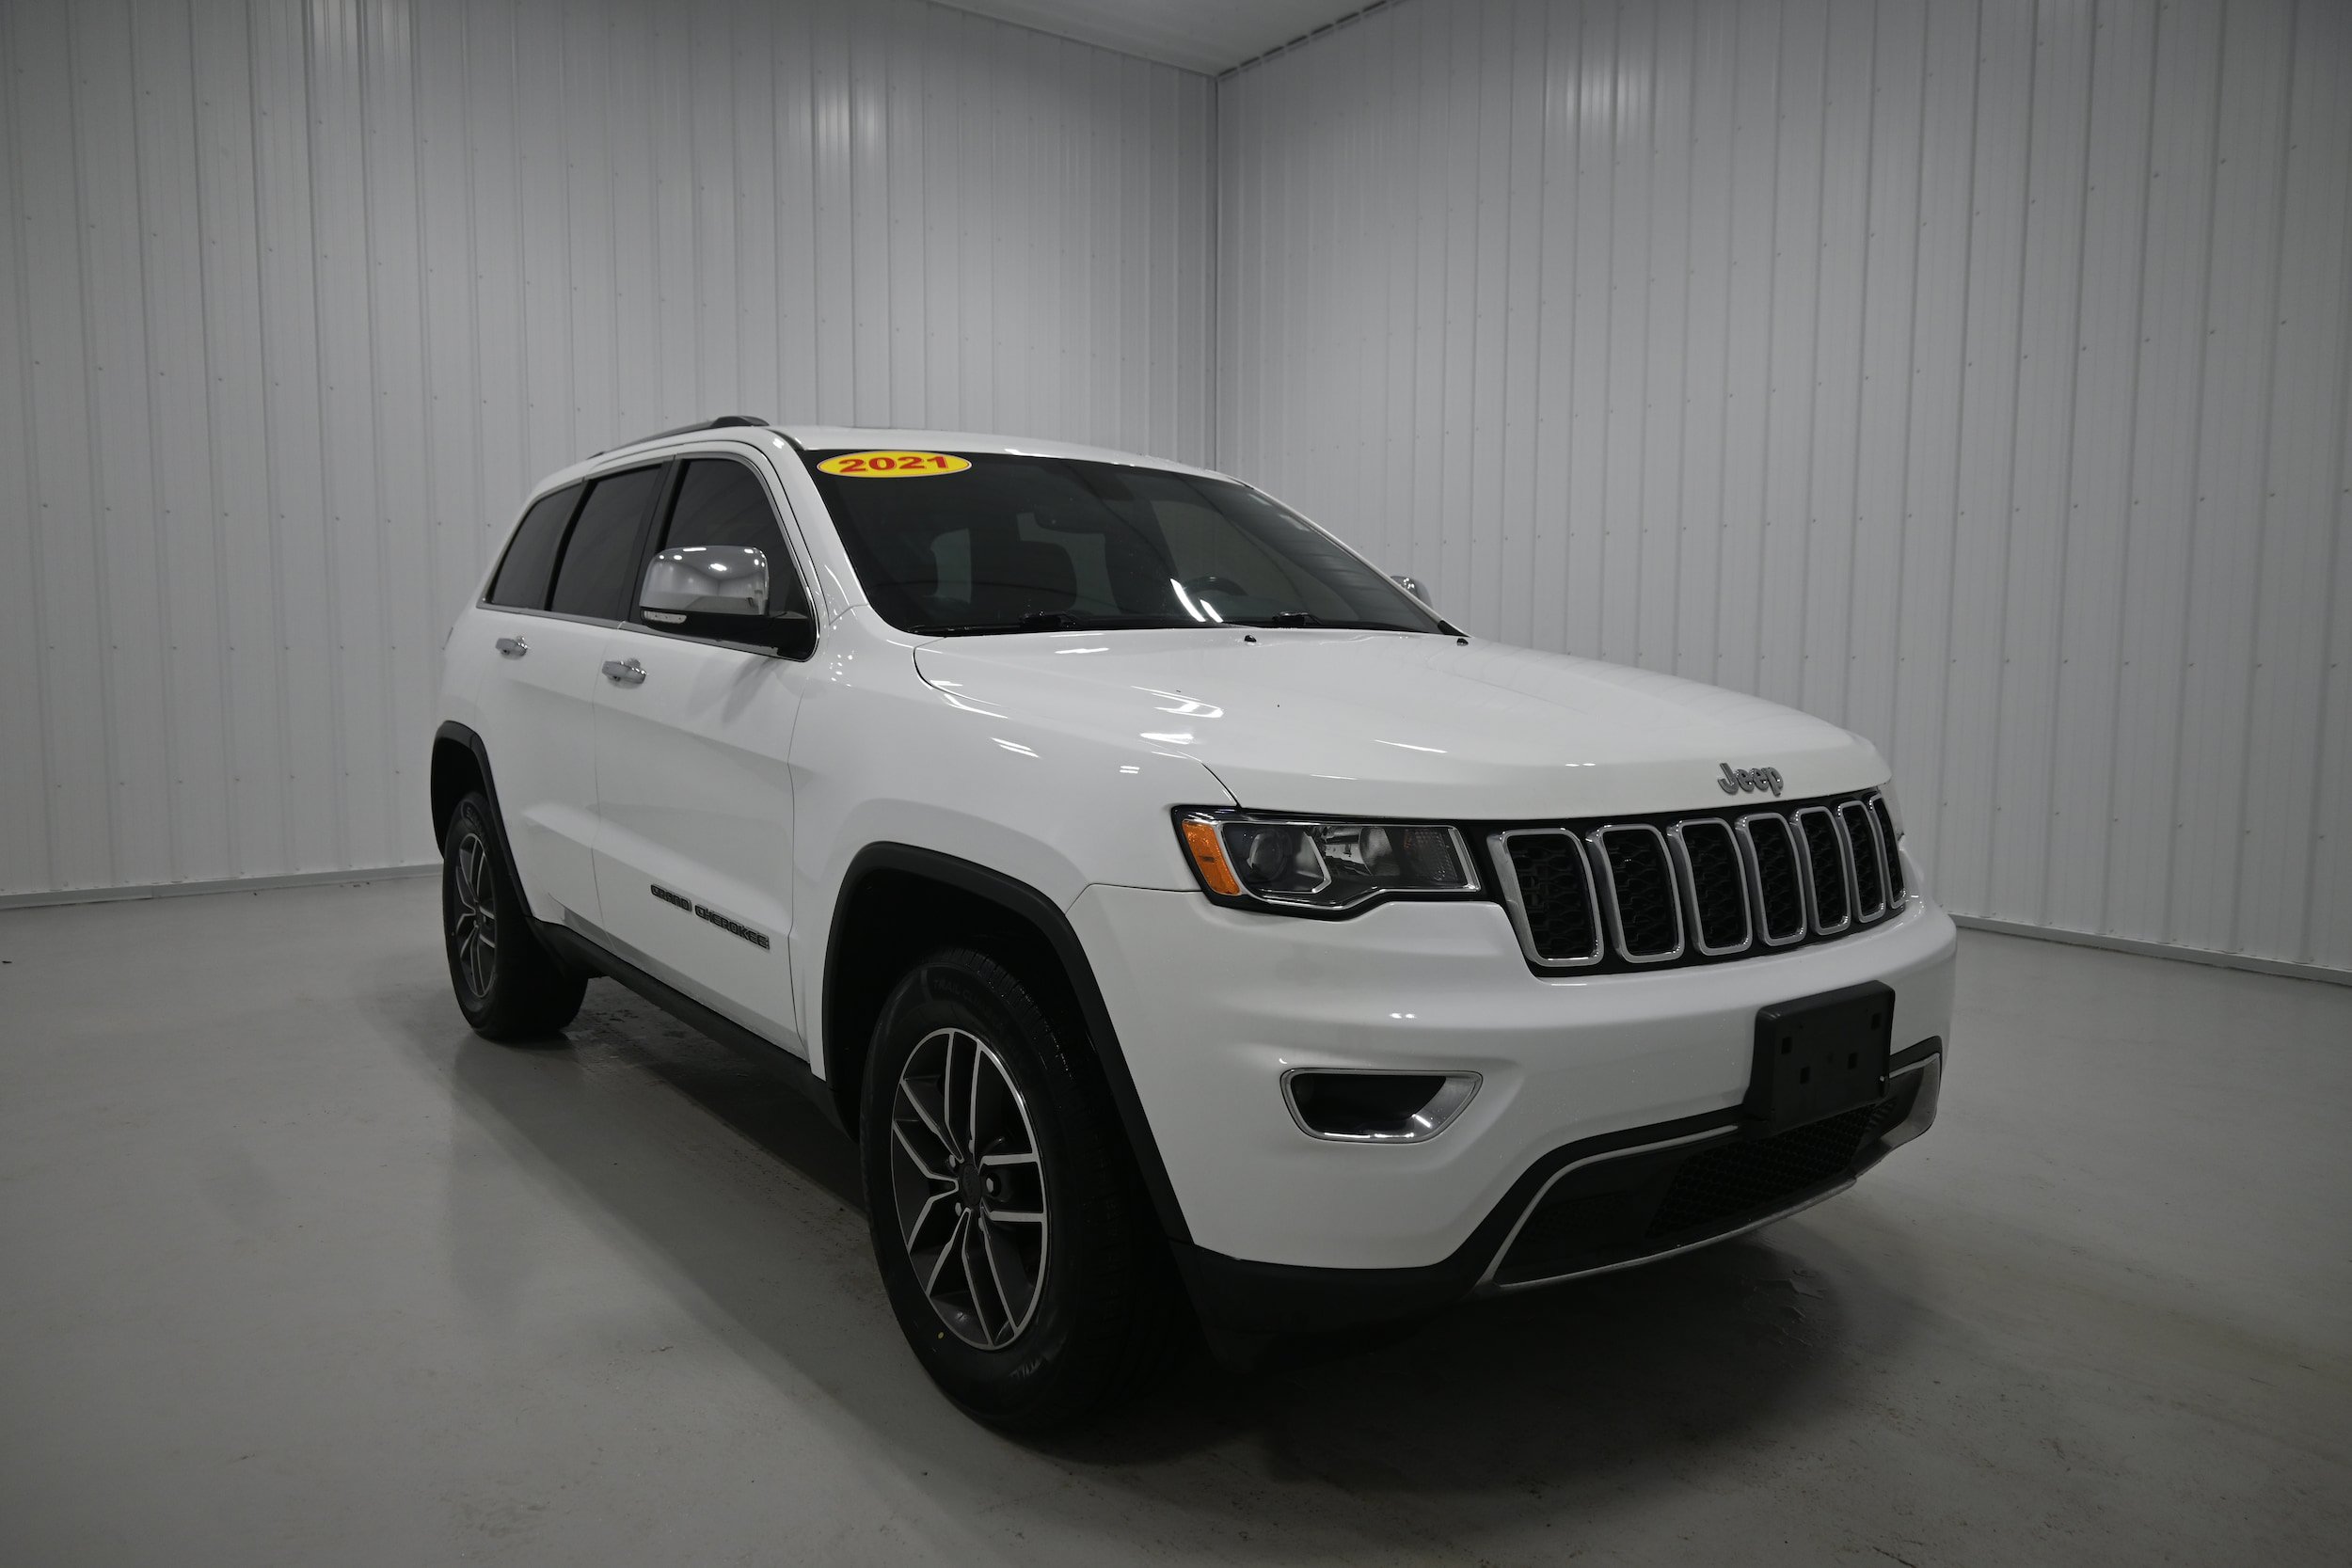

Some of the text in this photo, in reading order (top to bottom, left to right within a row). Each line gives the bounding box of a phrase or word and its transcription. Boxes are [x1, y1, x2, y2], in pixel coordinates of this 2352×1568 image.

[838, 455, 948, 473] 2021
[1717, 763, 1784, 797] Jeep
[650, 884, 771, 950] GRAND CHEROKEE
